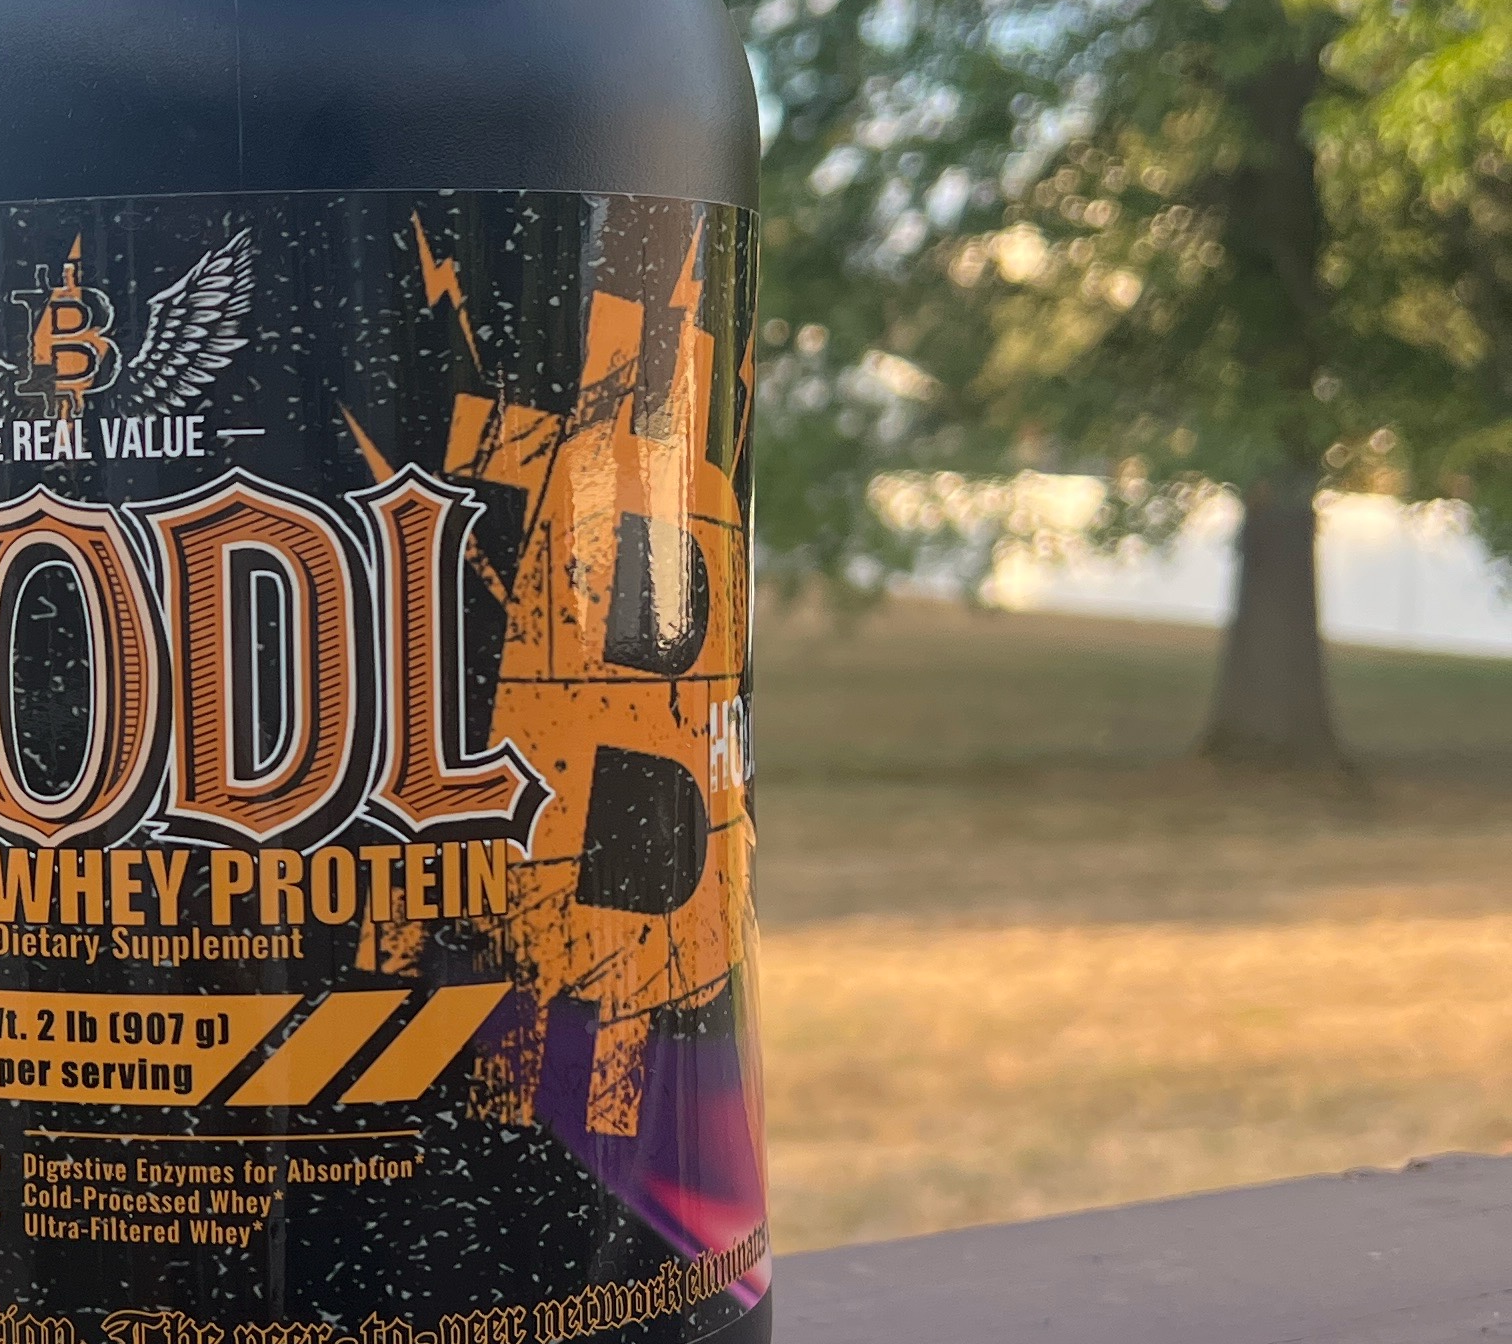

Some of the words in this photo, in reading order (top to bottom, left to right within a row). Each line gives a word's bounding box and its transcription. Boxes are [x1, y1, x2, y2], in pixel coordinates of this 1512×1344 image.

[12, 418, 93, 462] REAL
[99, 414, 206, 460] VALUE
[210, 838, 508, 927] PROTEIN
[112, 927, 304, 968] Supplement
[37, 1009, 55, 1042] 2
[66, 1010, 98, 1044] lb
[110, 1011, 184, 1046] (907
[195, 1013, 230, 1049] g)
[60, 1058, 193, 1094] serving
[23, 1152, 128, 1184] Digestive
[136, 1157, 235, 1187] Enzymes
[243, 1159, 277, 1184] for
[23, 1182, 200, 1214] Cold-Processed
[23, 1212, 180, 1244] Ultra-Filtered
